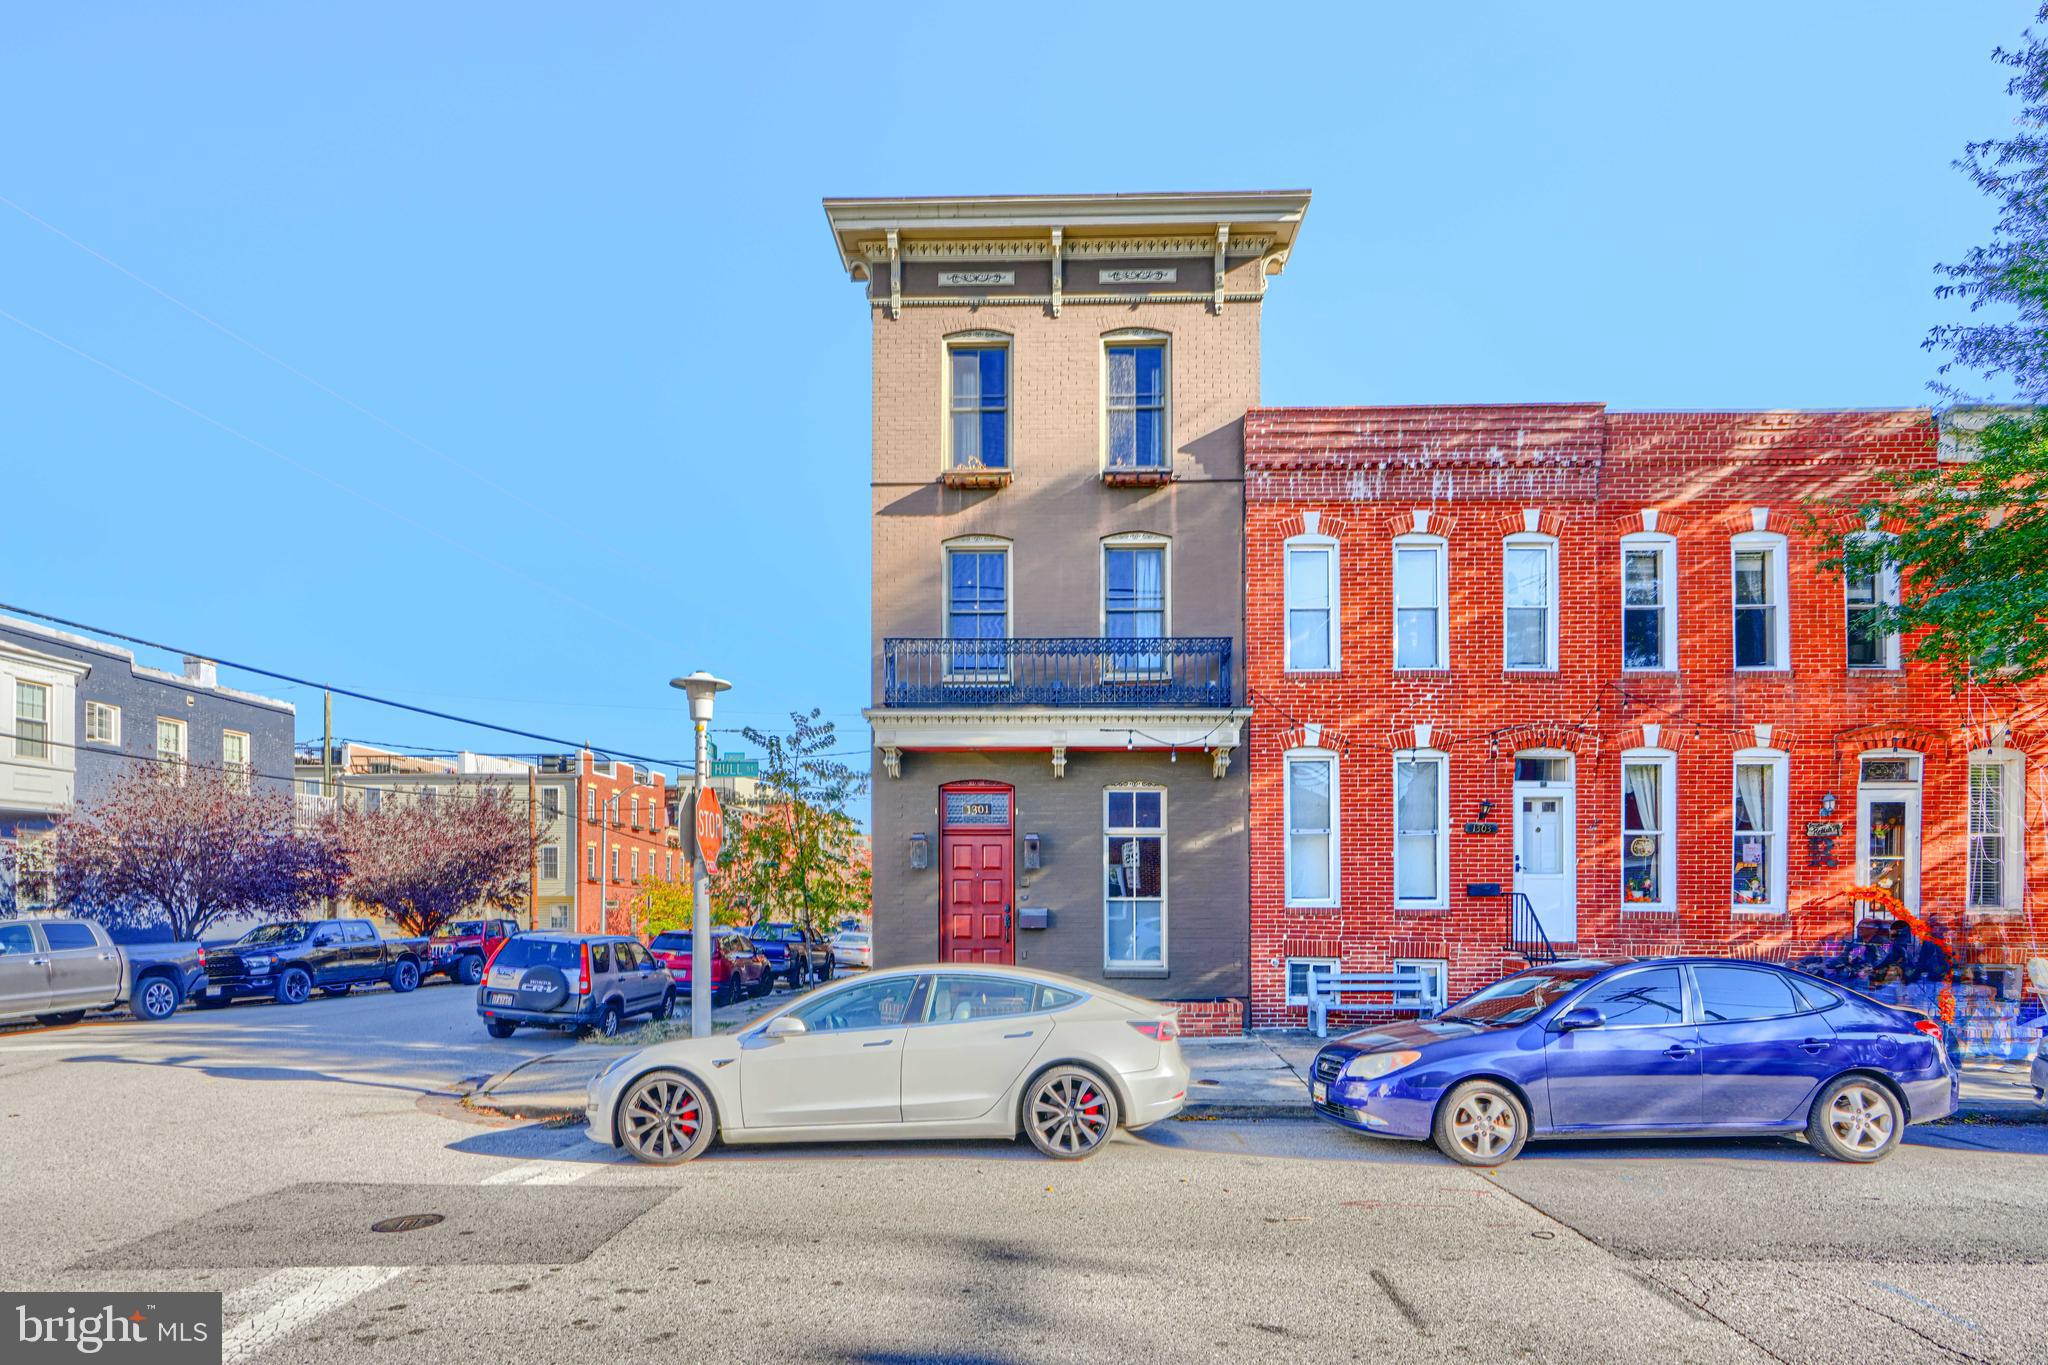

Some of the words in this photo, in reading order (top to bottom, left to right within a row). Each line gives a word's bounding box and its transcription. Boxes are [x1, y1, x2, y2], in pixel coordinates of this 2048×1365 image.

[714, 763, 742, 775] HULL
[965, 804, 989, 815] 1301
[698, 809, 721, 839] STOP
[1472, 824, 1492, 833] 1303
[521, 983, 559, 994] CR-V
